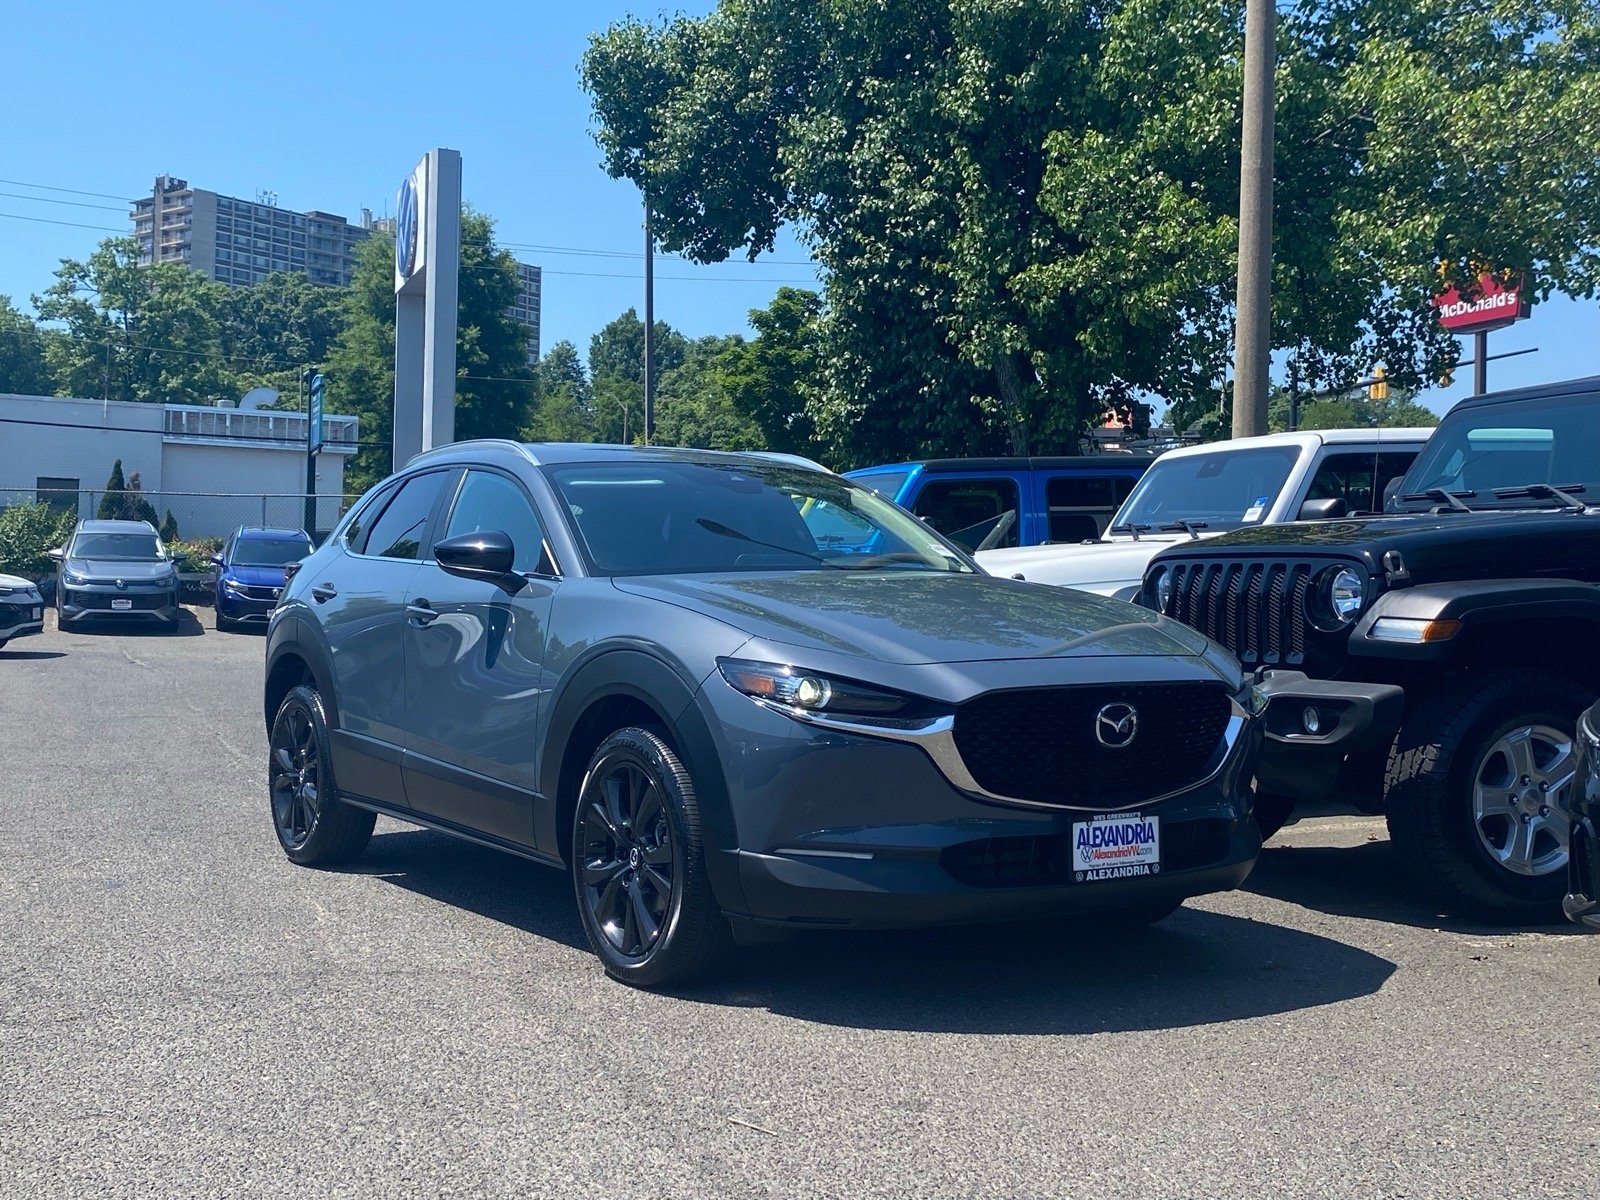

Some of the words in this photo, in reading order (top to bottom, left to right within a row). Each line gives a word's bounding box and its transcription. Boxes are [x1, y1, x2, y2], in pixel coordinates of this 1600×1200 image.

[1077, 822, 1155, 849] ALEXANDRIA
[1094, 846, 1152, 860] AlexandriaVW.com
[1086, 864, 1151, 881] ALEXANDRIA
